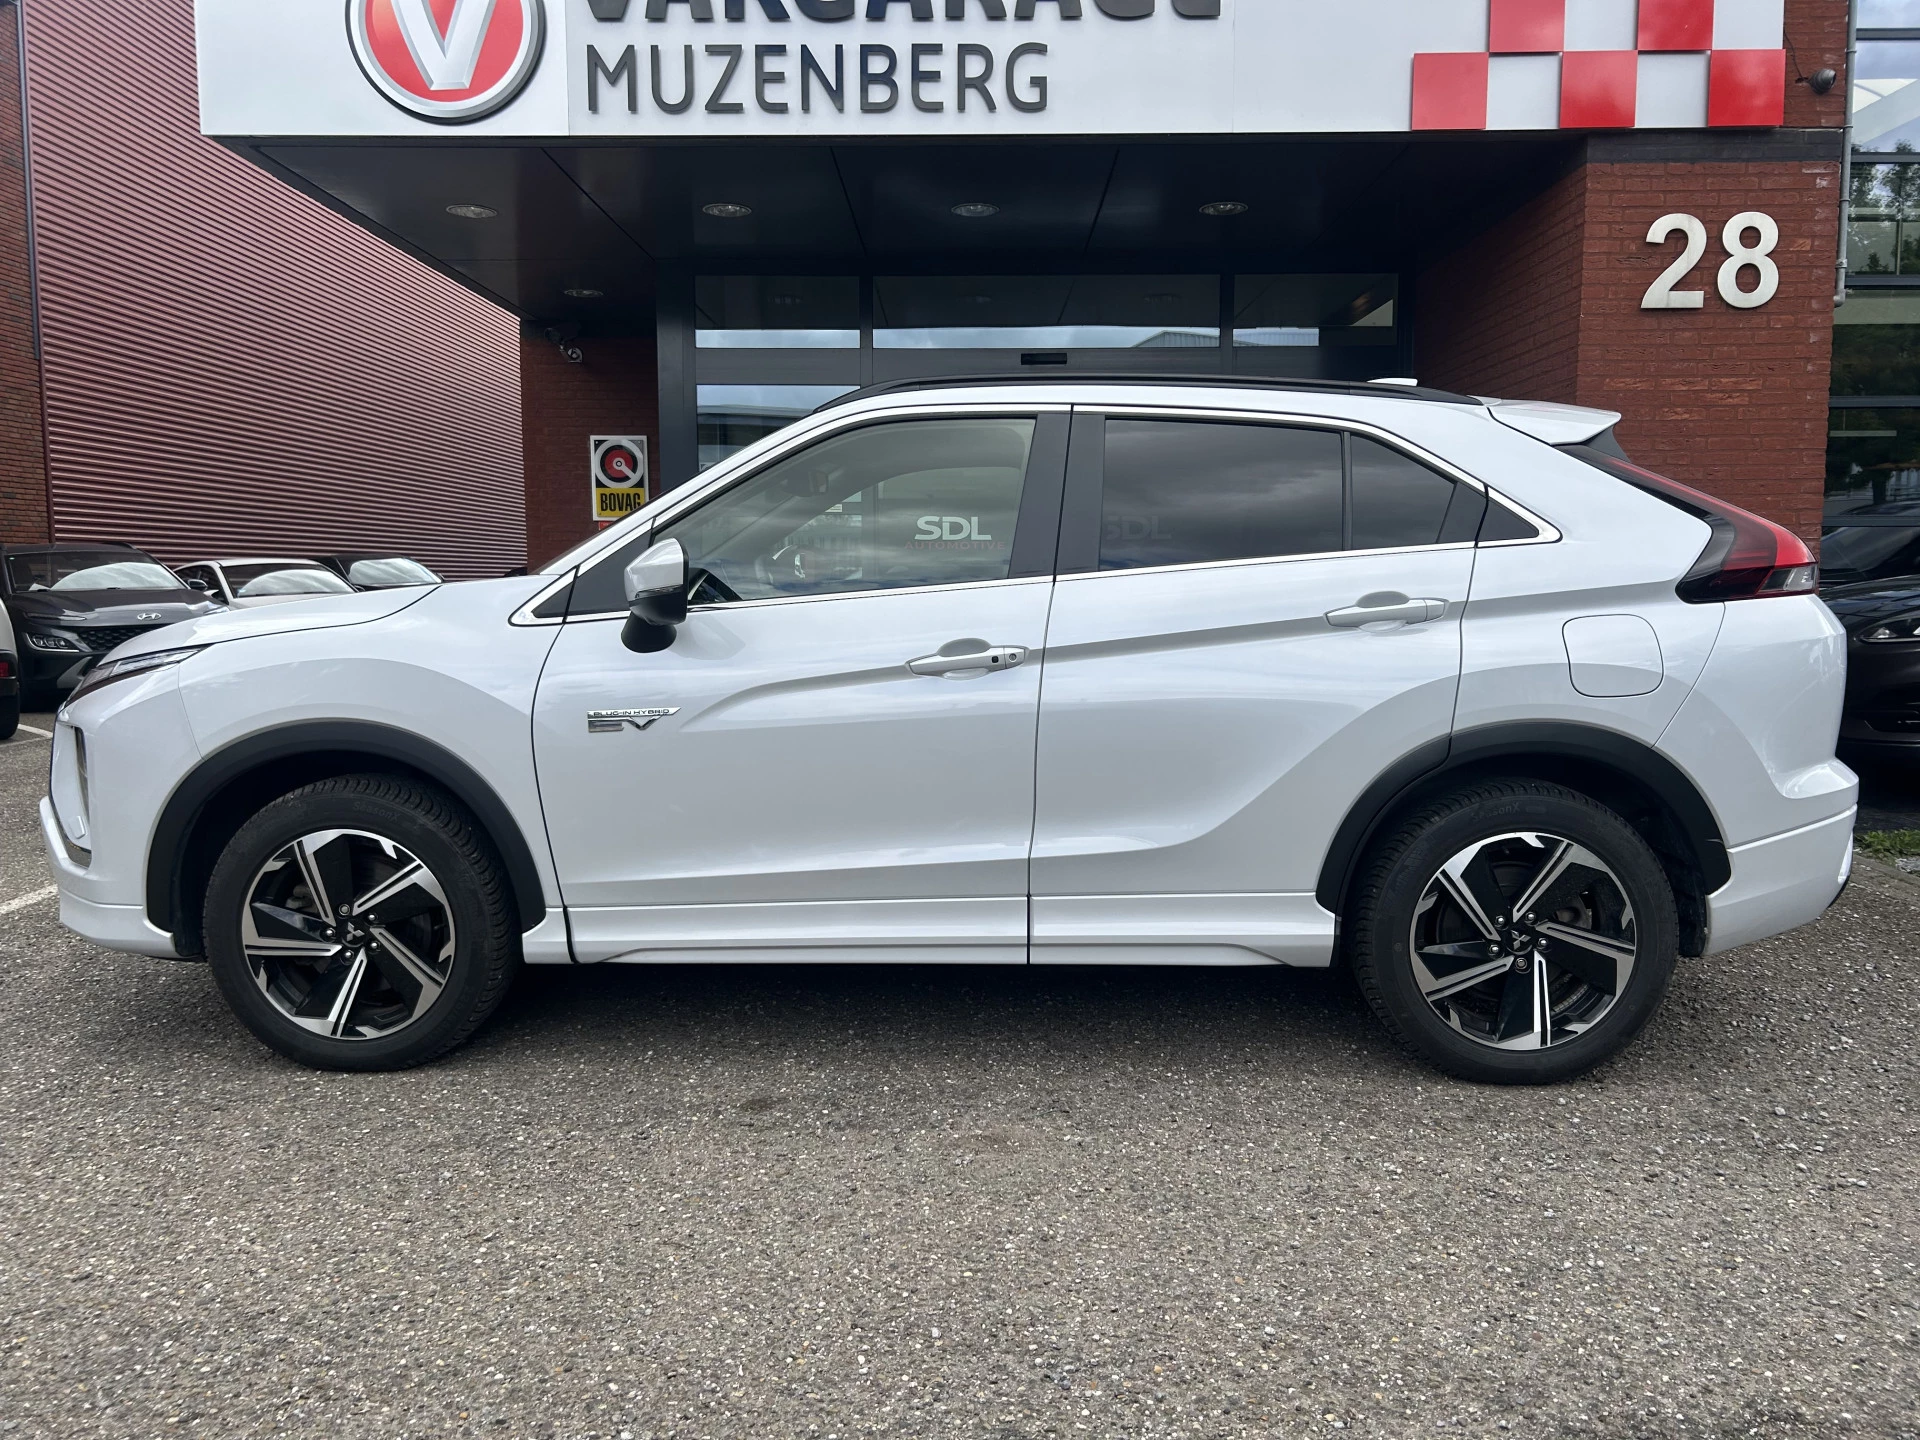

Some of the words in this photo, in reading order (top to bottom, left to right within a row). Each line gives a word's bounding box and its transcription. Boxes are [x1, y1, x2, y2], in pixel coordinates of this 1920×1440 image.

[586, 41, 1048, 115] MUZENBERG
[1641, 211, 1779, 309] 28
[601, 492, 641, 511] BOVAG
[914, 515, 992, 541] SDL
[904, 541, 1006, 551] AUTOMOTIVE
[633, 708, 670, 716] HYBRID
